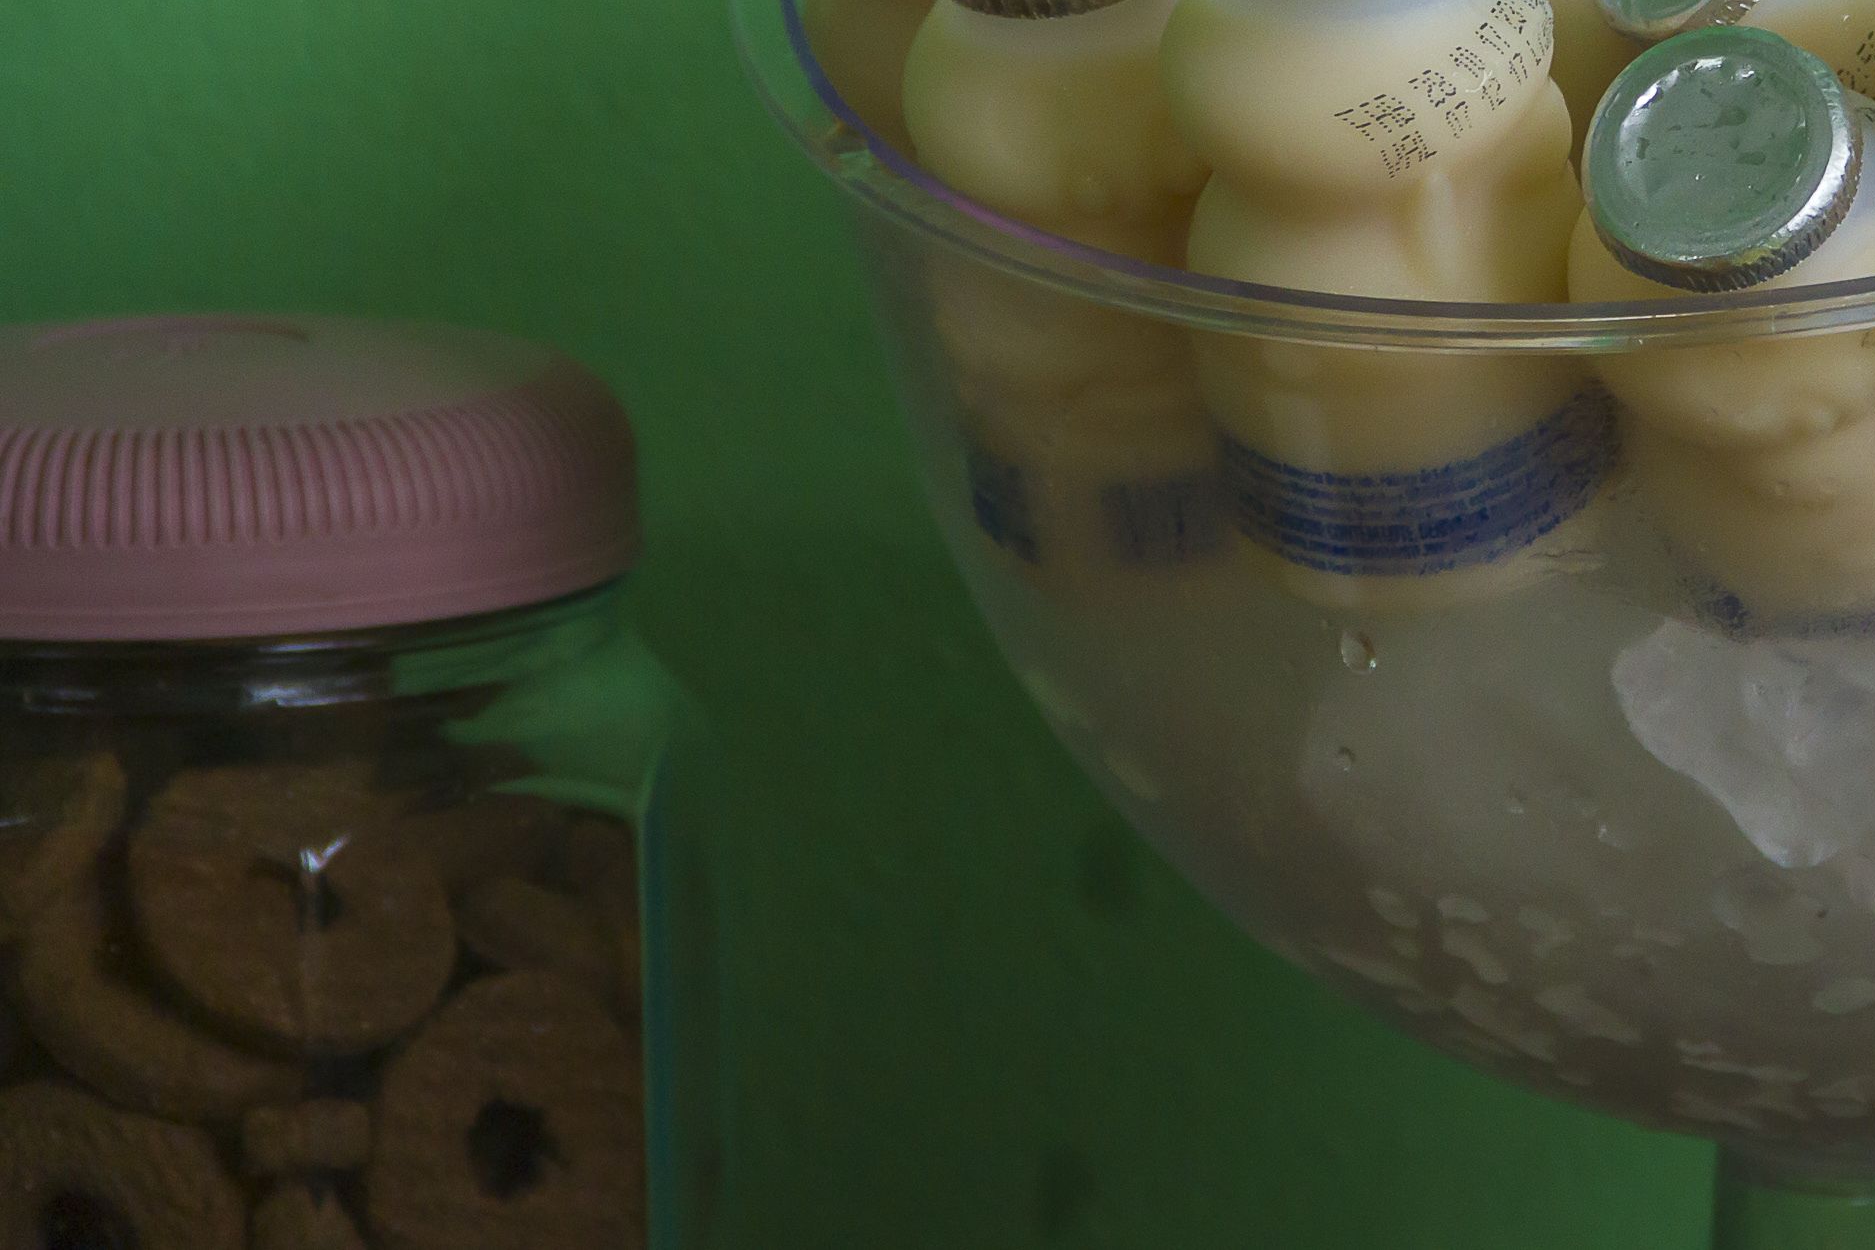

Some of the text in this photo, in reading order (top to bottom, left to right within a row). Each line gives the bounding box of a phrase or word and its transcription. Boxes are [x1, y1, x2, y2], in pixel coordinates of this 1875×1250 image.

[1334, 93, 1416, 142] FAB
[1408, 68, 1457, 108] 28
[1449, 46, 1486, 78] 10
[1475, 22, 1511, 56] 17
[1379, 130, 1438, 179] VAL
[1445, 101, 1472, 140] 07
